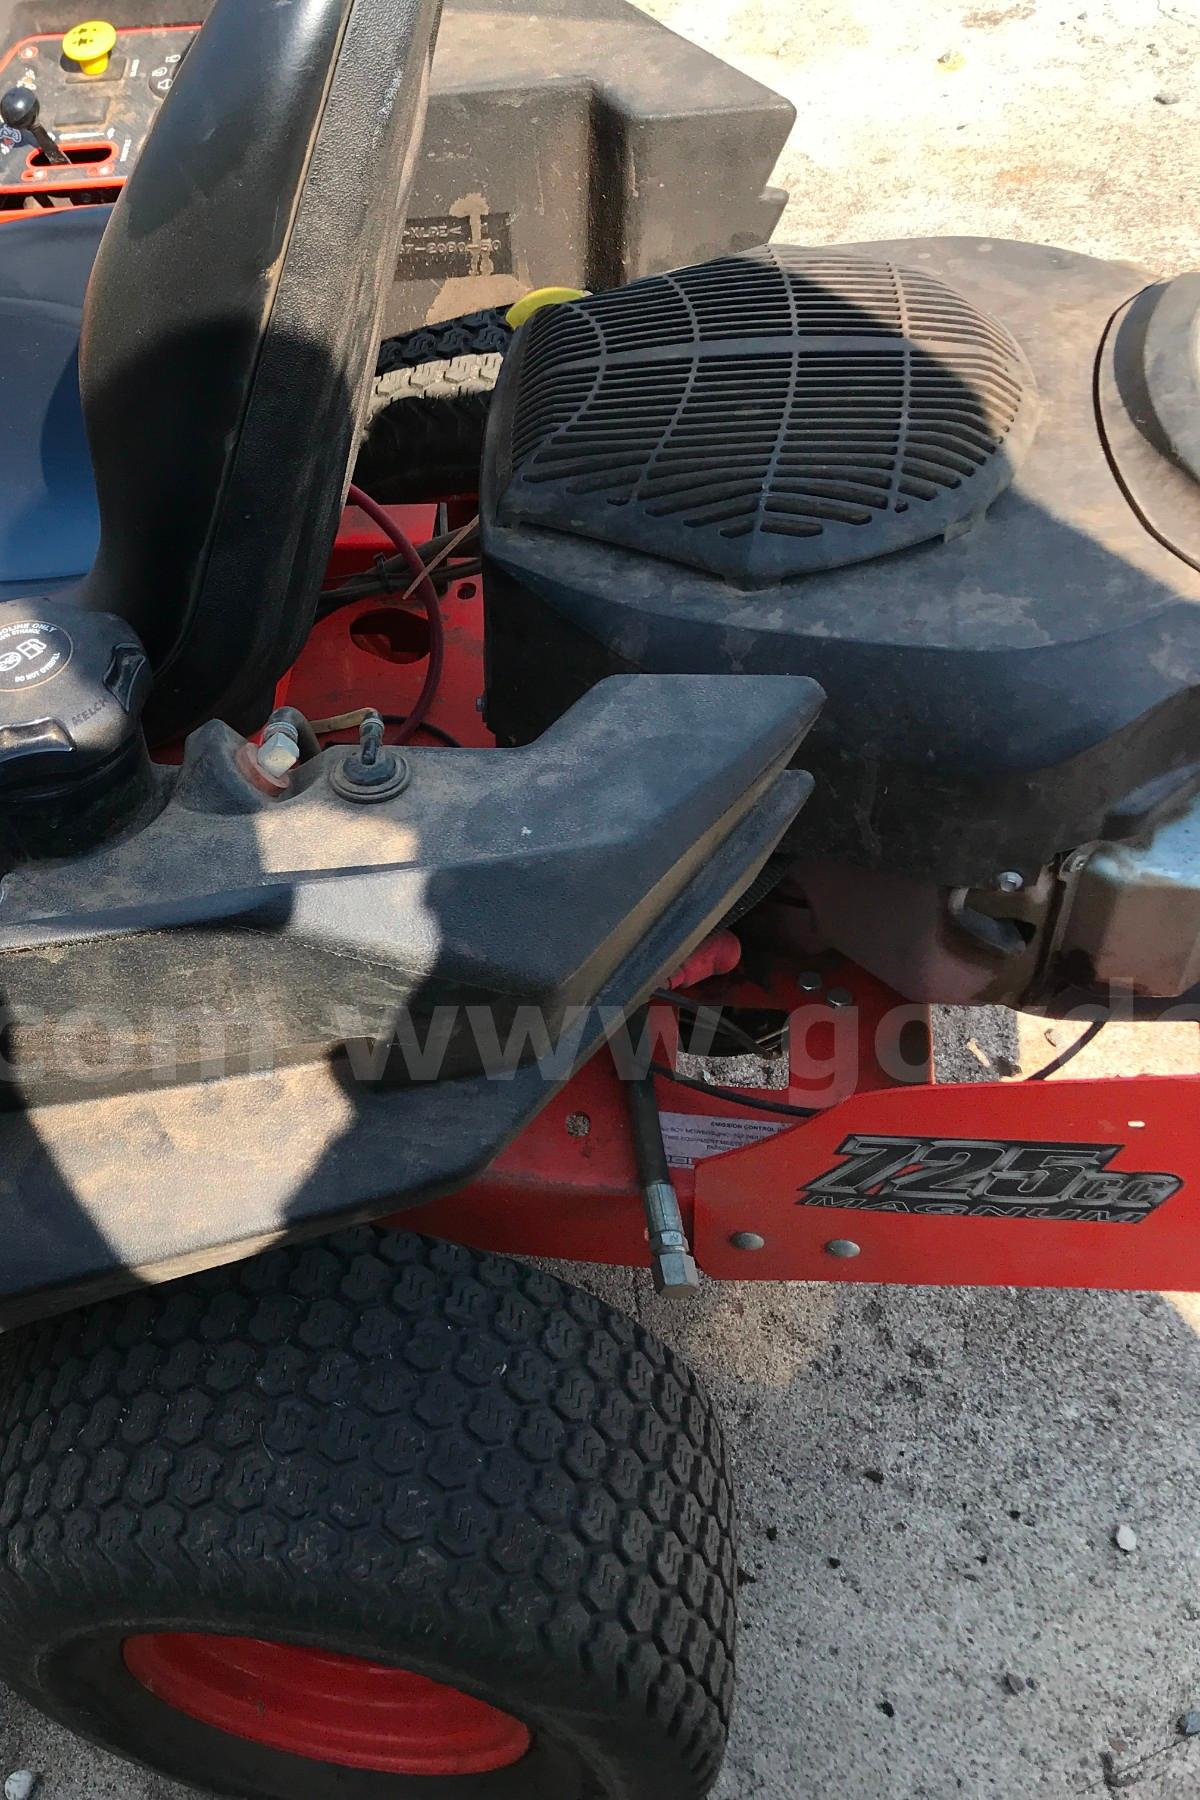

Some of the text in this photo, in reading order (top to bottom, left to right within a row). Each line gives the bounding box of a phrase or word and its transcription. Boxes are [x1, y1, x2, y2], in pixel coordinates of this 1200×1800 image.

[32, 622, 58, 633] ONLY
[14, 675, 26, 683] DO
[25, 671, 40, 681] NOT
[743, 1123, 776, 1132] CONTROL
[806, 1195, 1149, 1223] MAGNUM
